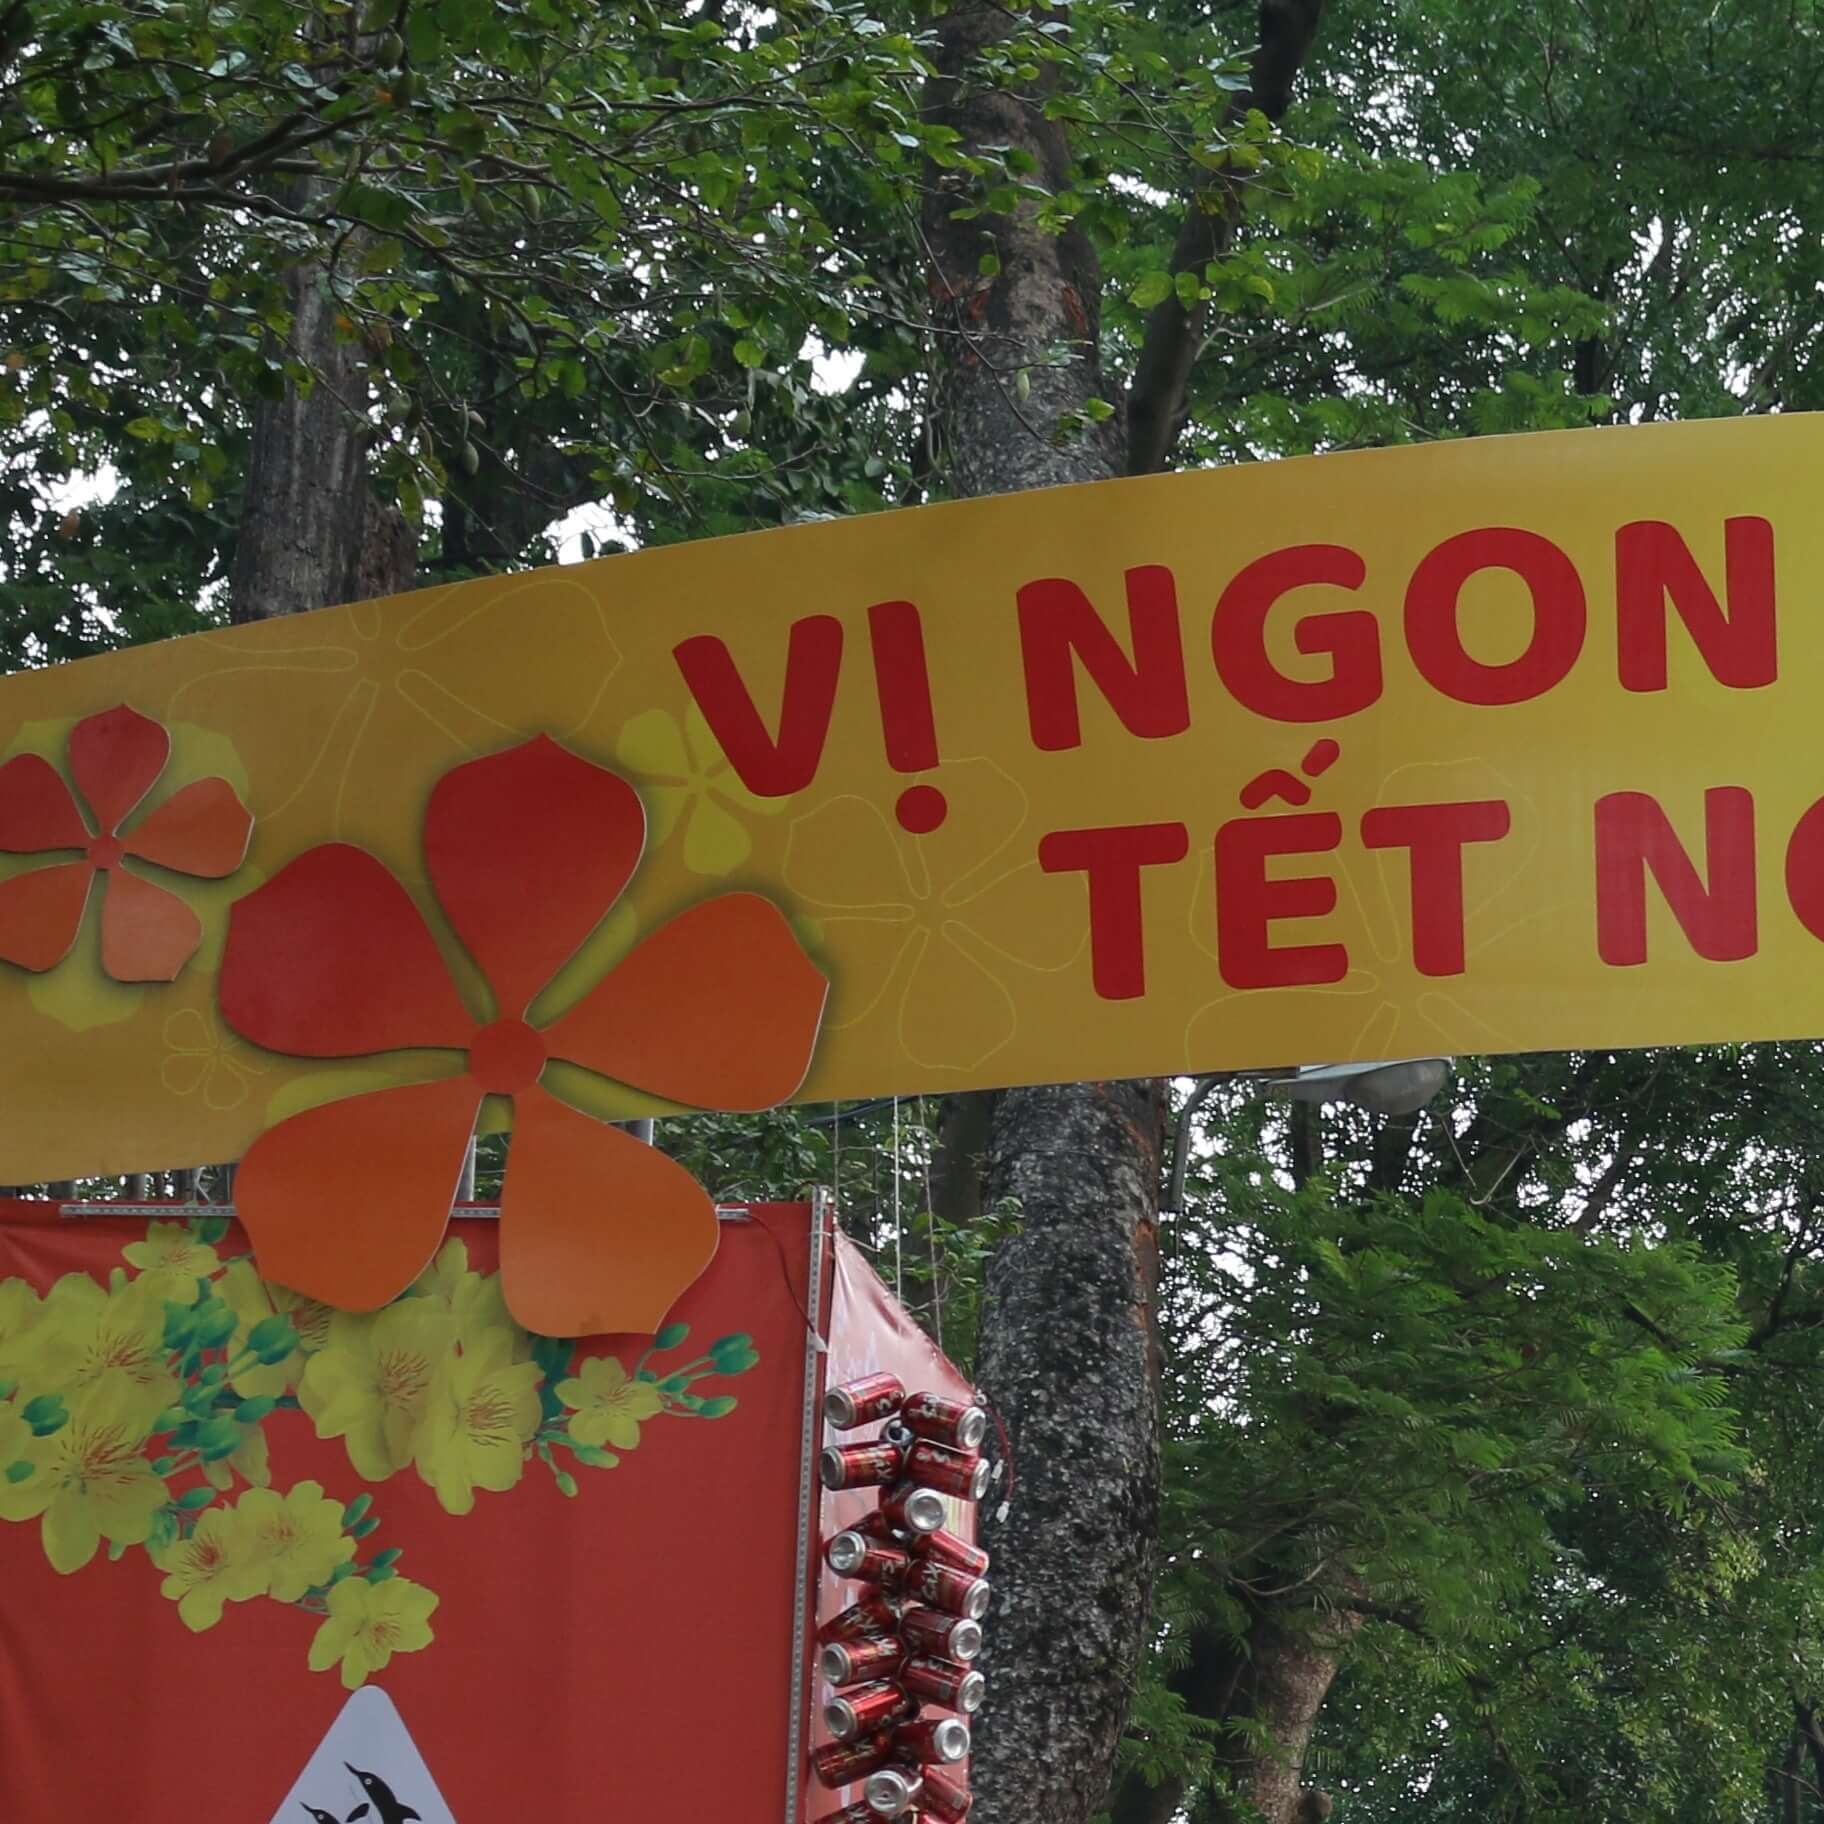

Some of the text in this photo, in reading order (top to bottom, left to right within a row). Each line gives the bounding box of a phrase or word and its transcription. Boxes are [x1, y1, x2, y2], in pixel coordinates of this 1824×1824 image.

[672, 515, 1777, 834] VỊ NGON
[1038, 738, 1510, 1000] TẾT
